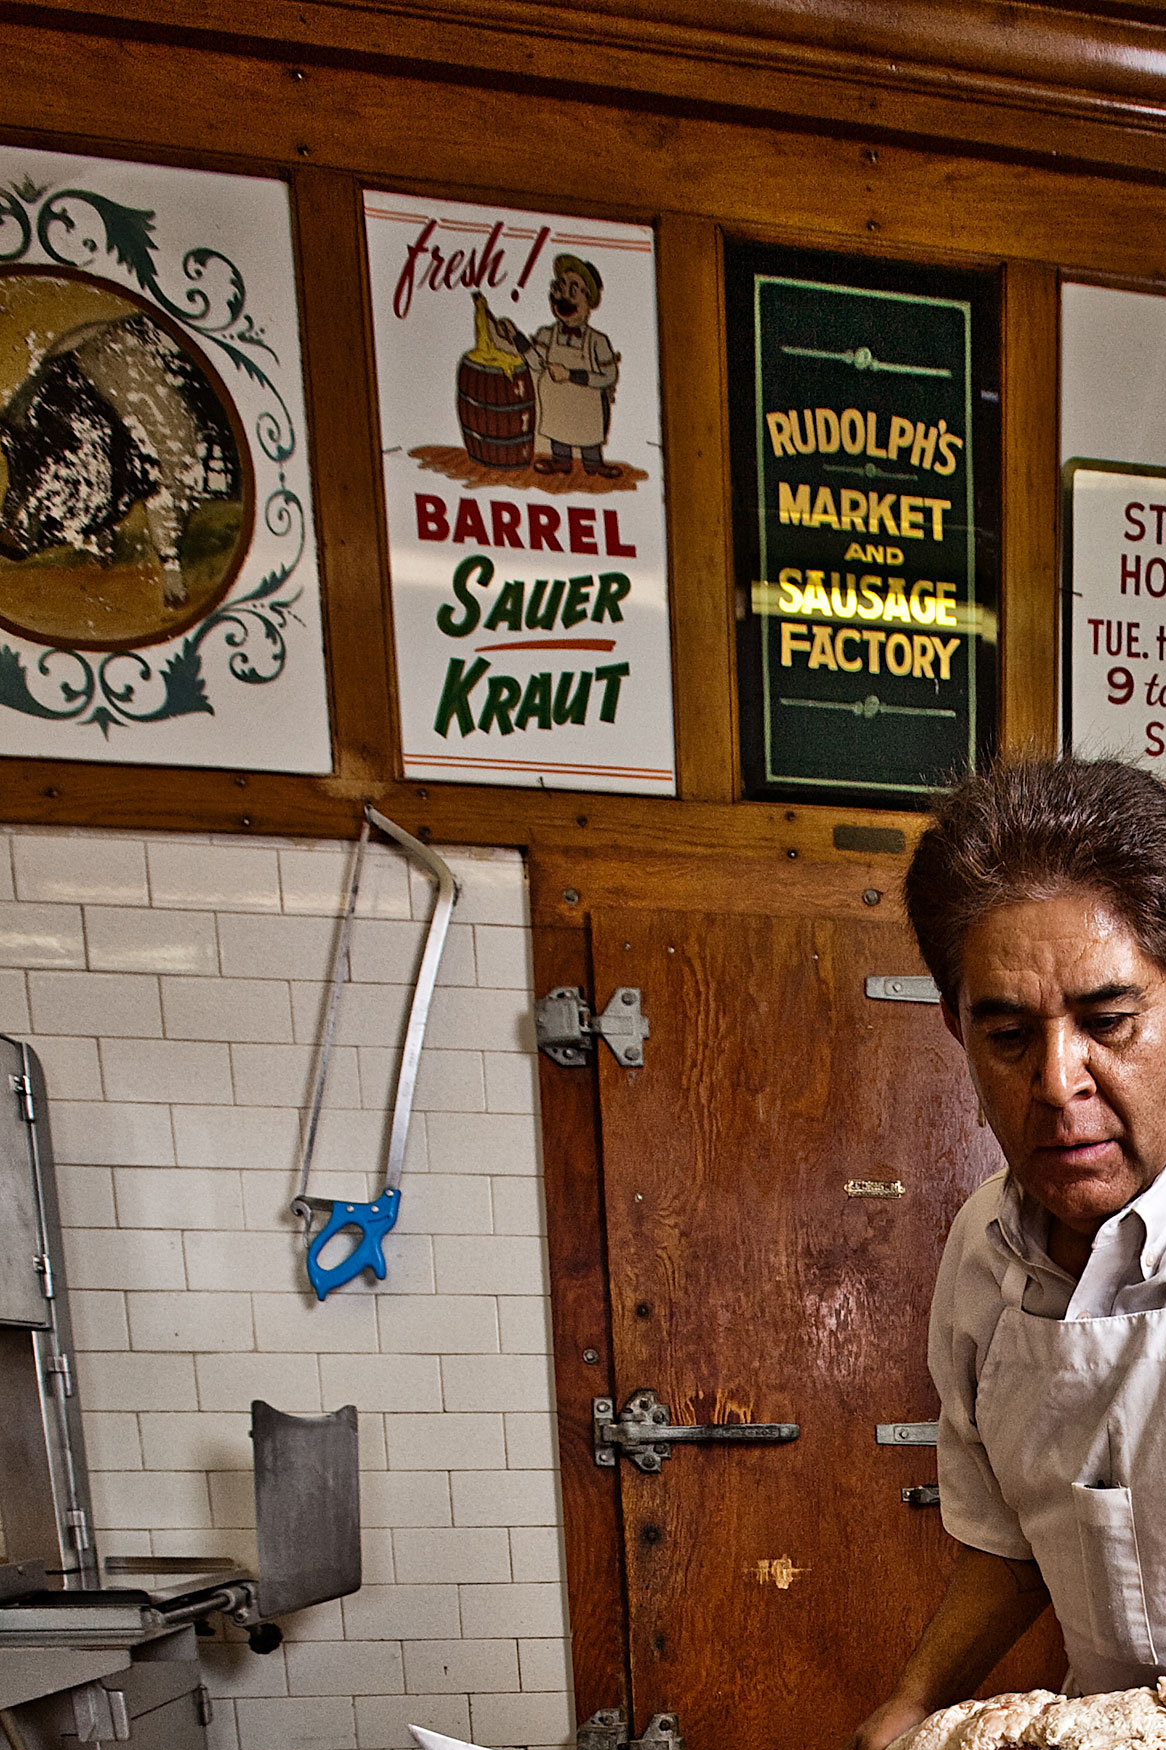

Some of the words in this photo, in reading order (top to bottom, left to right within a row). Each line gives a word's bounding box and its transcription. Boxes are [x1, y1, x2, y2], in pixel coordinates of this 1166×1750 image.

[393, 219, 551, 320] fresh!
[765, 408, 963, 476] RUDOLPH'S
[414, 492, 637, 558] BARREL
[778, 481, 951, 541] MARKET
[844, 541, 905, 566] AND
[778, 567, 958, 627] SAUSAGE
[780, 622, 961, 681] FACTORY
[1087, 618, 1149, 660] TUE.
[1106, 666, 1135, 705] 9
